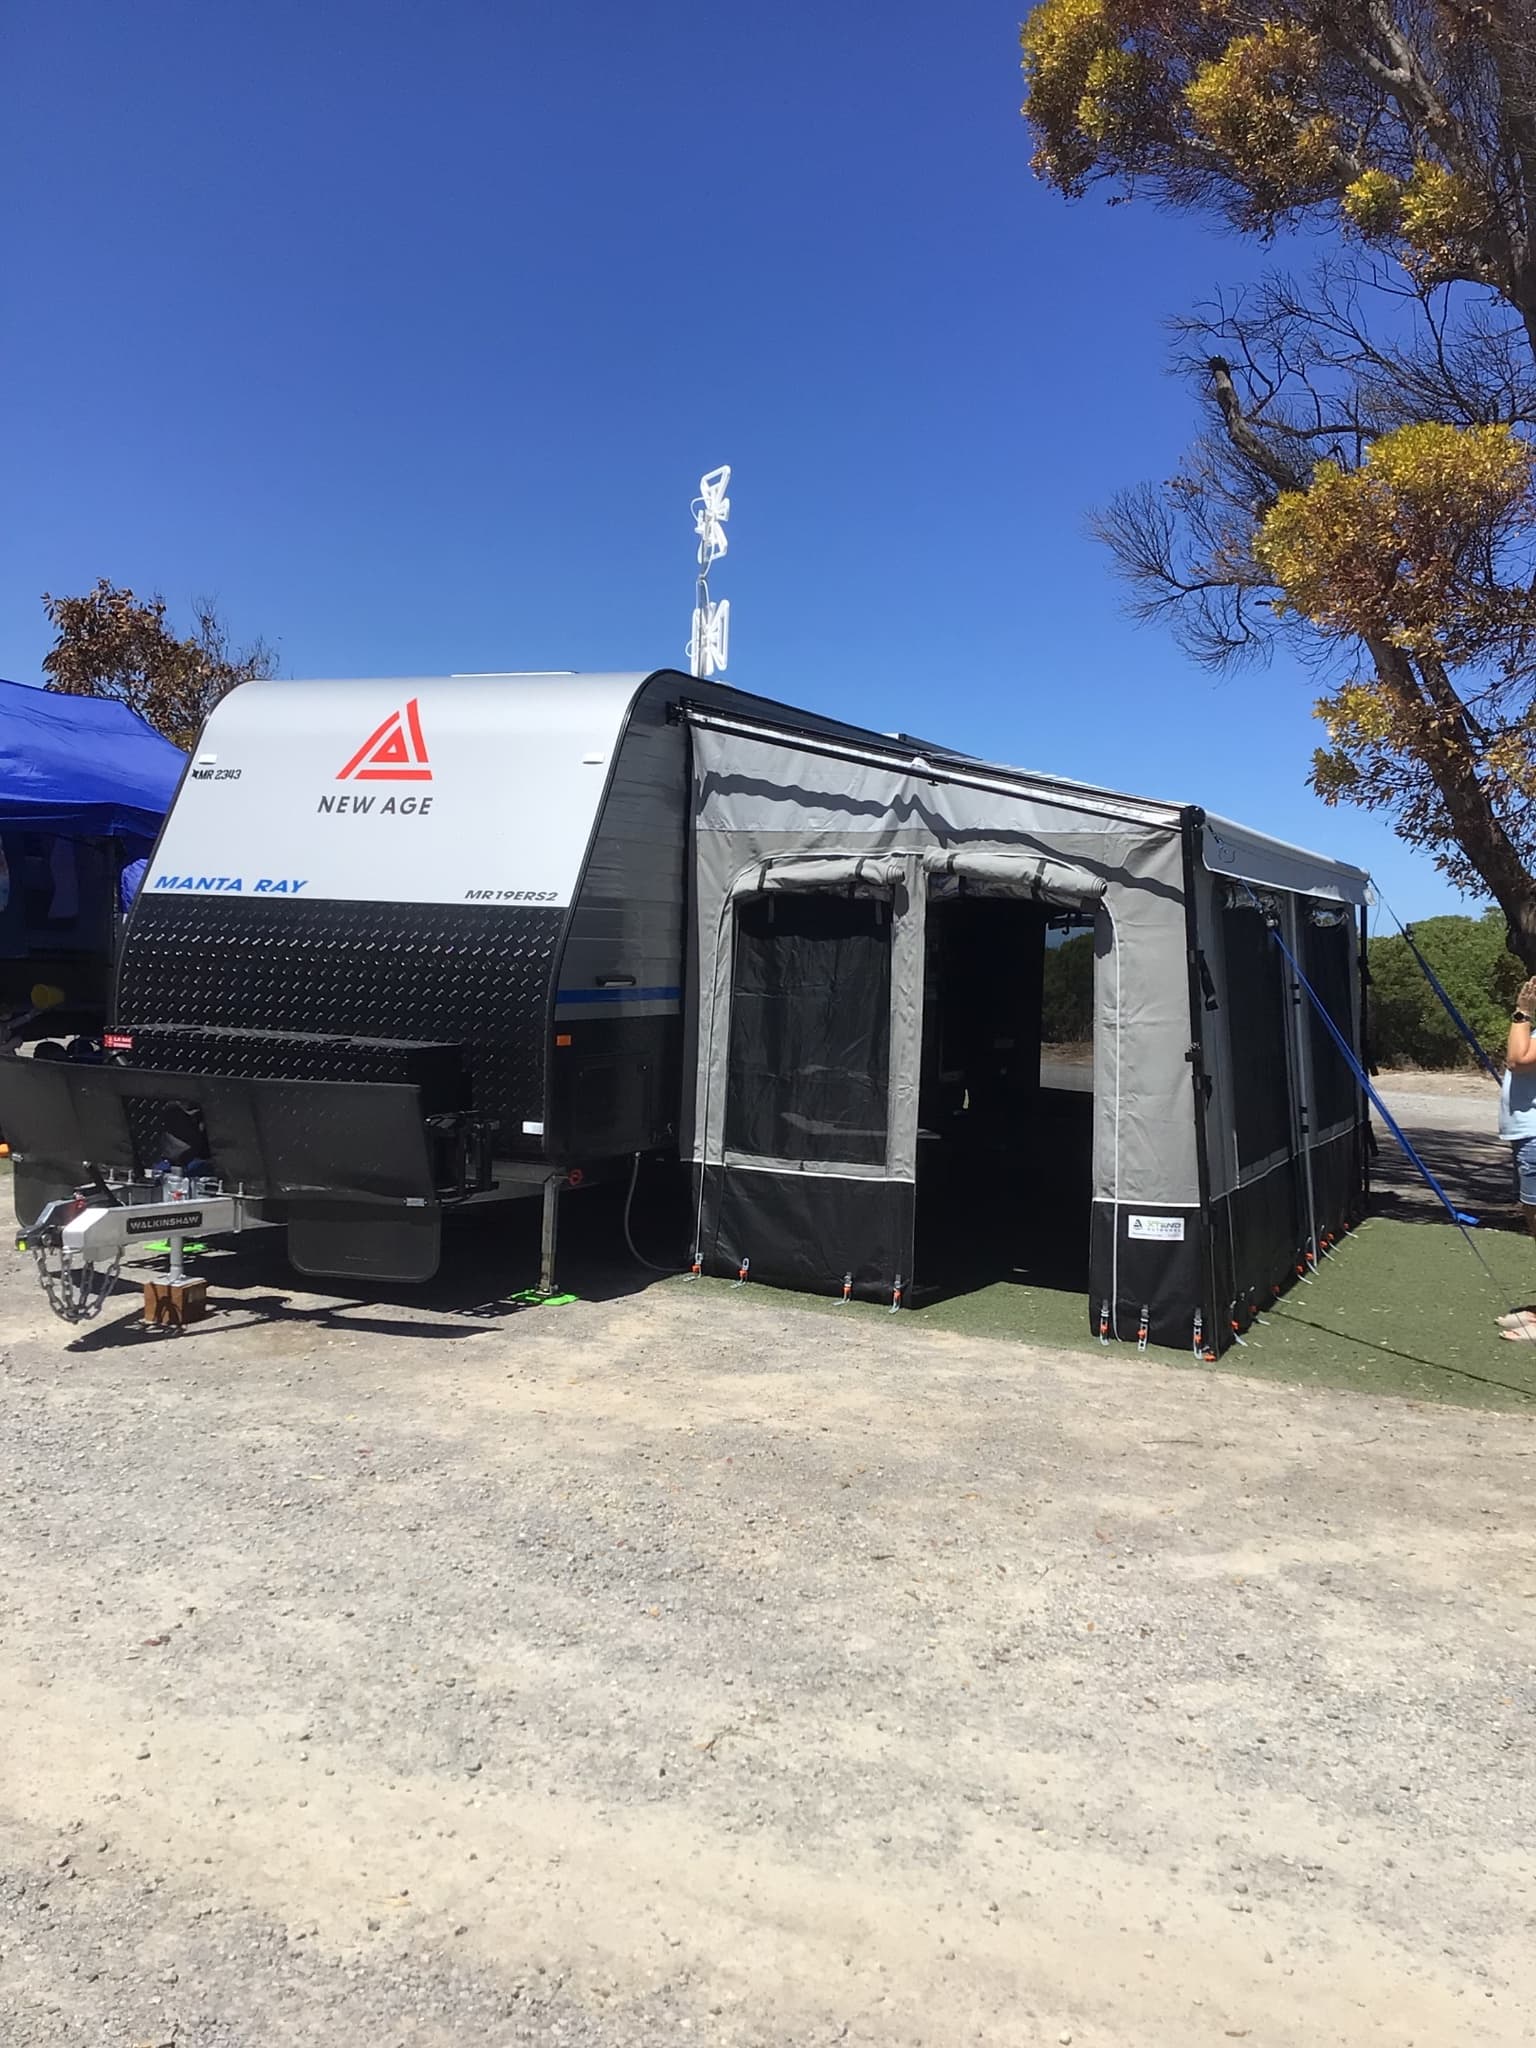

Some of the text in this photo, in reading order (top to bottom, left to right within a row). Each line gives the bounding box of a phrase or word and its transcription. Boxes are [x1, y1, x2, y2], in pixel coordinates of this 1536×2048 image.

[317, 795, 434, 815] NEW AGE
[154, 876, 309, 894] MANTA RAY
[464, 889, 558, 902] MR19ERS2
[130, 1216, 199, 1230] WALKINSHAW
